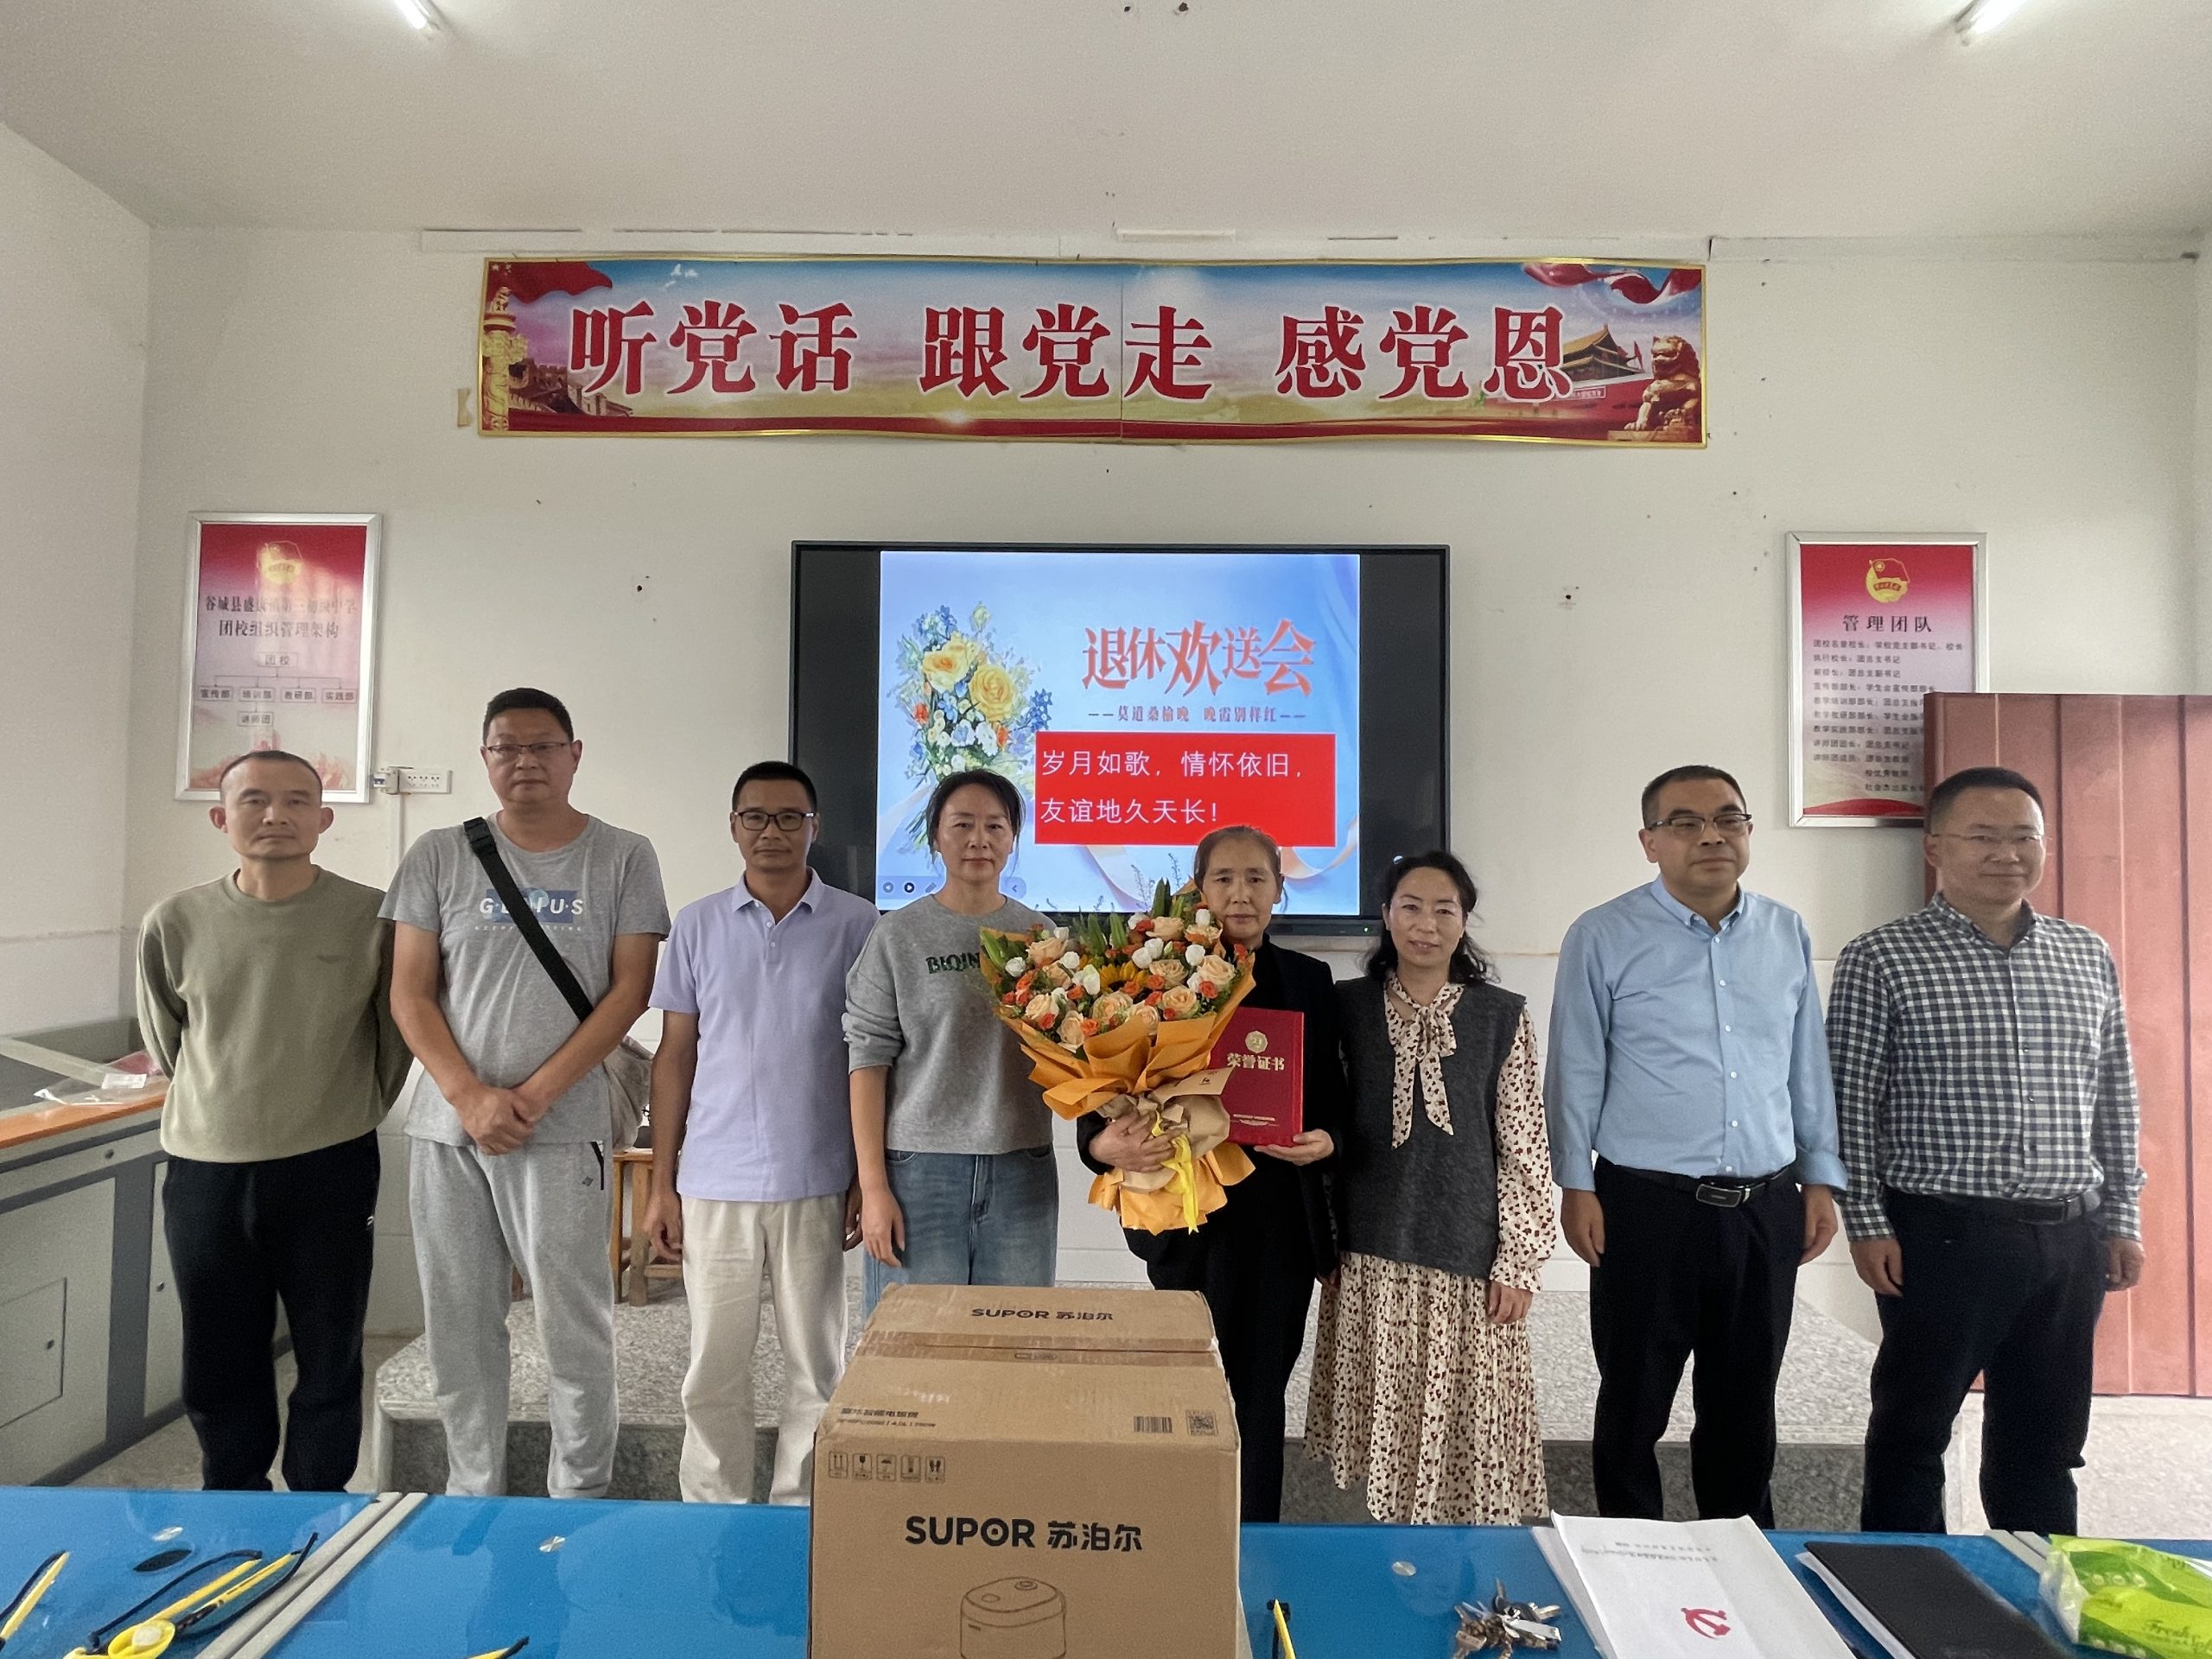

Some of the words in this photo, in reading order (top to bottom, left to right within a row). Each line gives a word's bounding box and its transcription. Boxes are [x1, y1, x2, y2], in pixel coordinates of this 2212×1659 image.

[570, 300, 858, 397] 听党话
[919, 304, 1212, 399] 跟党走
[1276, 305, 1573, 401] 感党恩
[1843, 614, 1932, 632] 管理团队
[1082, 619, 1315, 697] 退休欢送会
[1227, 1053, 1286, 1071] 荣誉证书
[971, 1309, 1050, 1319] SUPOR
[1056, 1311, 1114, 1320] 苏泊尔
[906, 1516, 1035, 1548] SUPOR
[1047, 1520, 1142, 1553] 苏泊尔
